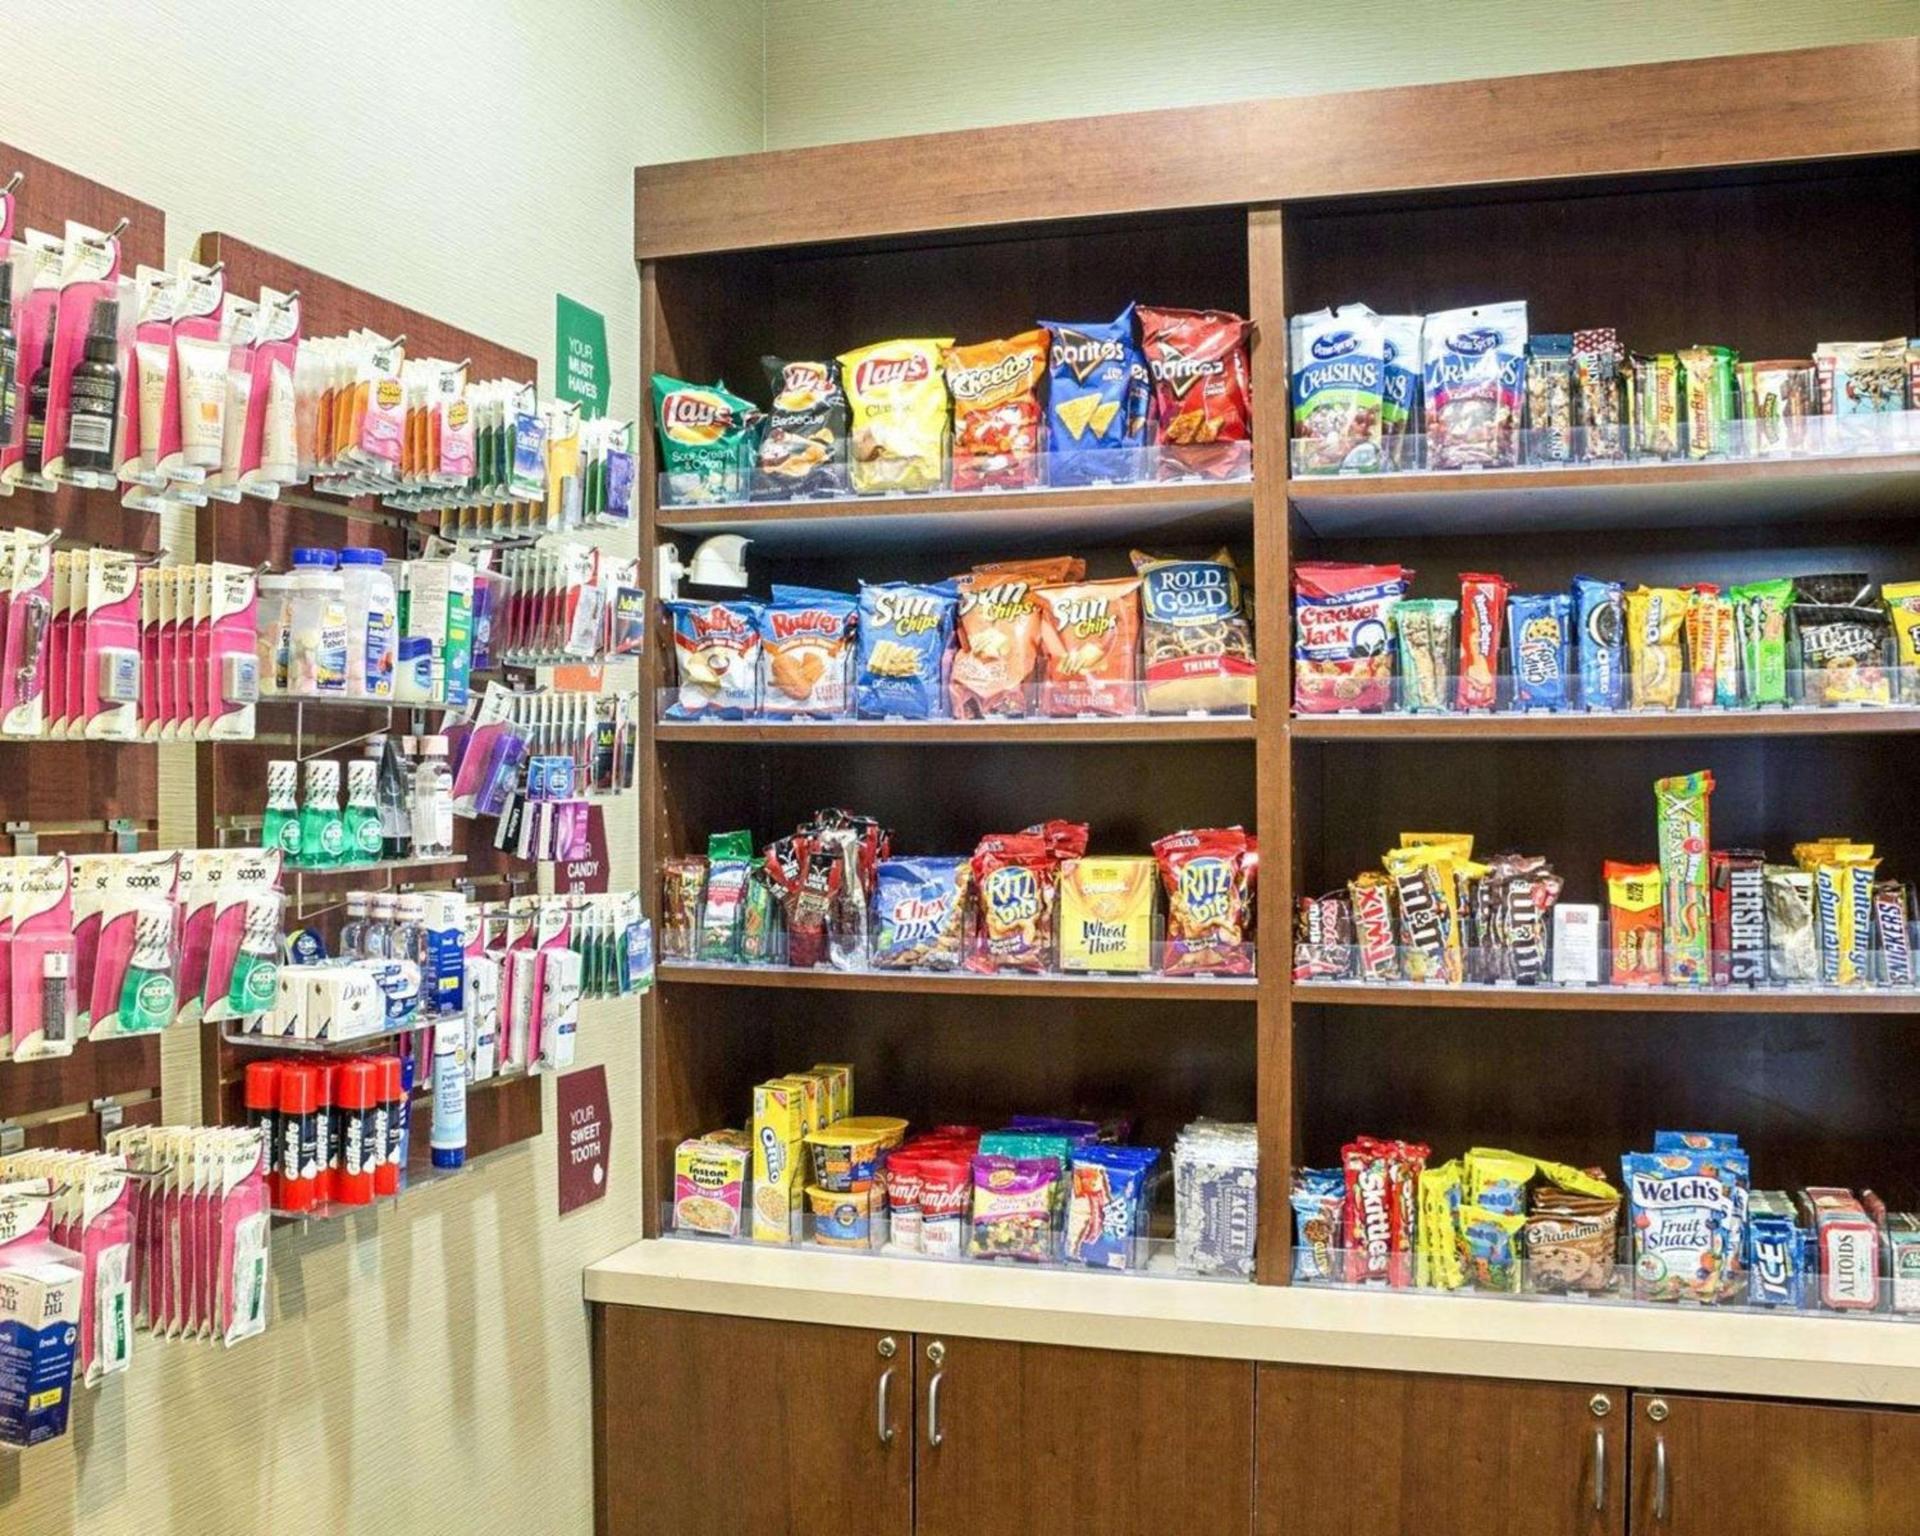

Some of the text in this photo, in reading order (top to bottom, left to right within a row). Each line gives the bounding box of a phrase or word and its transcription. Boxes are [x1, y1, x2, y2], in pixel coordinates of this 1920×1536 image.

[567, 337, 594, 360] YOUR
[1053, 339, 1124, 368] Doritos
[567, 357, 595, 380] MUST
[952, 349, 1034, 399] Cheetos
[1153, 358, 1225, 381] Doritos
[1300, 361, 1377, 397] CRAISINS
[567, 376, 598, 399] HAVES
[1161, 569, 1222, 591] ROLD
[870, 592, 935, 628] Sun
[958, 581, 1028, 616] Sun
[1156, 588, 1228, 614] GOLD
[771, 608, 840, 639] Ruffles
[981, 600, 1034, 623] Chips
[1052, 597, 1109, 632] Sun
[1299, 603, 1380, 627] Cracker
[1646, 595, 1661, 643] OREO
[895, 613, 940, 637] Chips
[1074, 611, 1117, 638] Chips
[1301, 626, 1350, 647] Jack
[1182, 659, 1219, 673] THINS
[1597, 649, 1611, 694] OREO
[127, 874, 161, 889] scope
[237, 868, 267, 882] scope
[566, 861, 600, 878] CANDY
[1181, 864, 1232, 898] RITZ
[569, 881, 586, 896] JAR
[986, 872, 1037, 903] RITZ
[893, 894, 948, 922] Chex
[1082, 920, 1127, 940] Wheat
[1731, 870, 1765, 983] HERSHEY'S
[1087, 937, 1127, 956] Thins
[1876, 900, 1907, 985] SNICKERS
[569, 1104, 595, 1126] YOUR
[569, 1122, 601, 1146] SWEET
[284, 1120, 299, 1181] Gillette
[347, 1117, 363, 1176] Gillette
[569, 1141, 601, 1165] TOOTH
[760, 1126, 780, 1184] OREO
[688, 1165, 729, 1179] Instant
[692, 1174, 725, 1187] Lunch
[1637, 1180, 1720, 1203] Welch's
[1111, 1199, 1129, 1239] POP
[1358, 1171, 1391, 1271] Skittles
[1659, 1218, 1702, 1234] Fruit
[1647, 1231, 1710, 1250] Snacks
[1756, 1243, 1787, 1295] ICE
[1839, 1234, 1855, 1297] ALTOIDS
[45, 1288, 65, 1302] re-
[43, 1301, 63, 1317] nu
